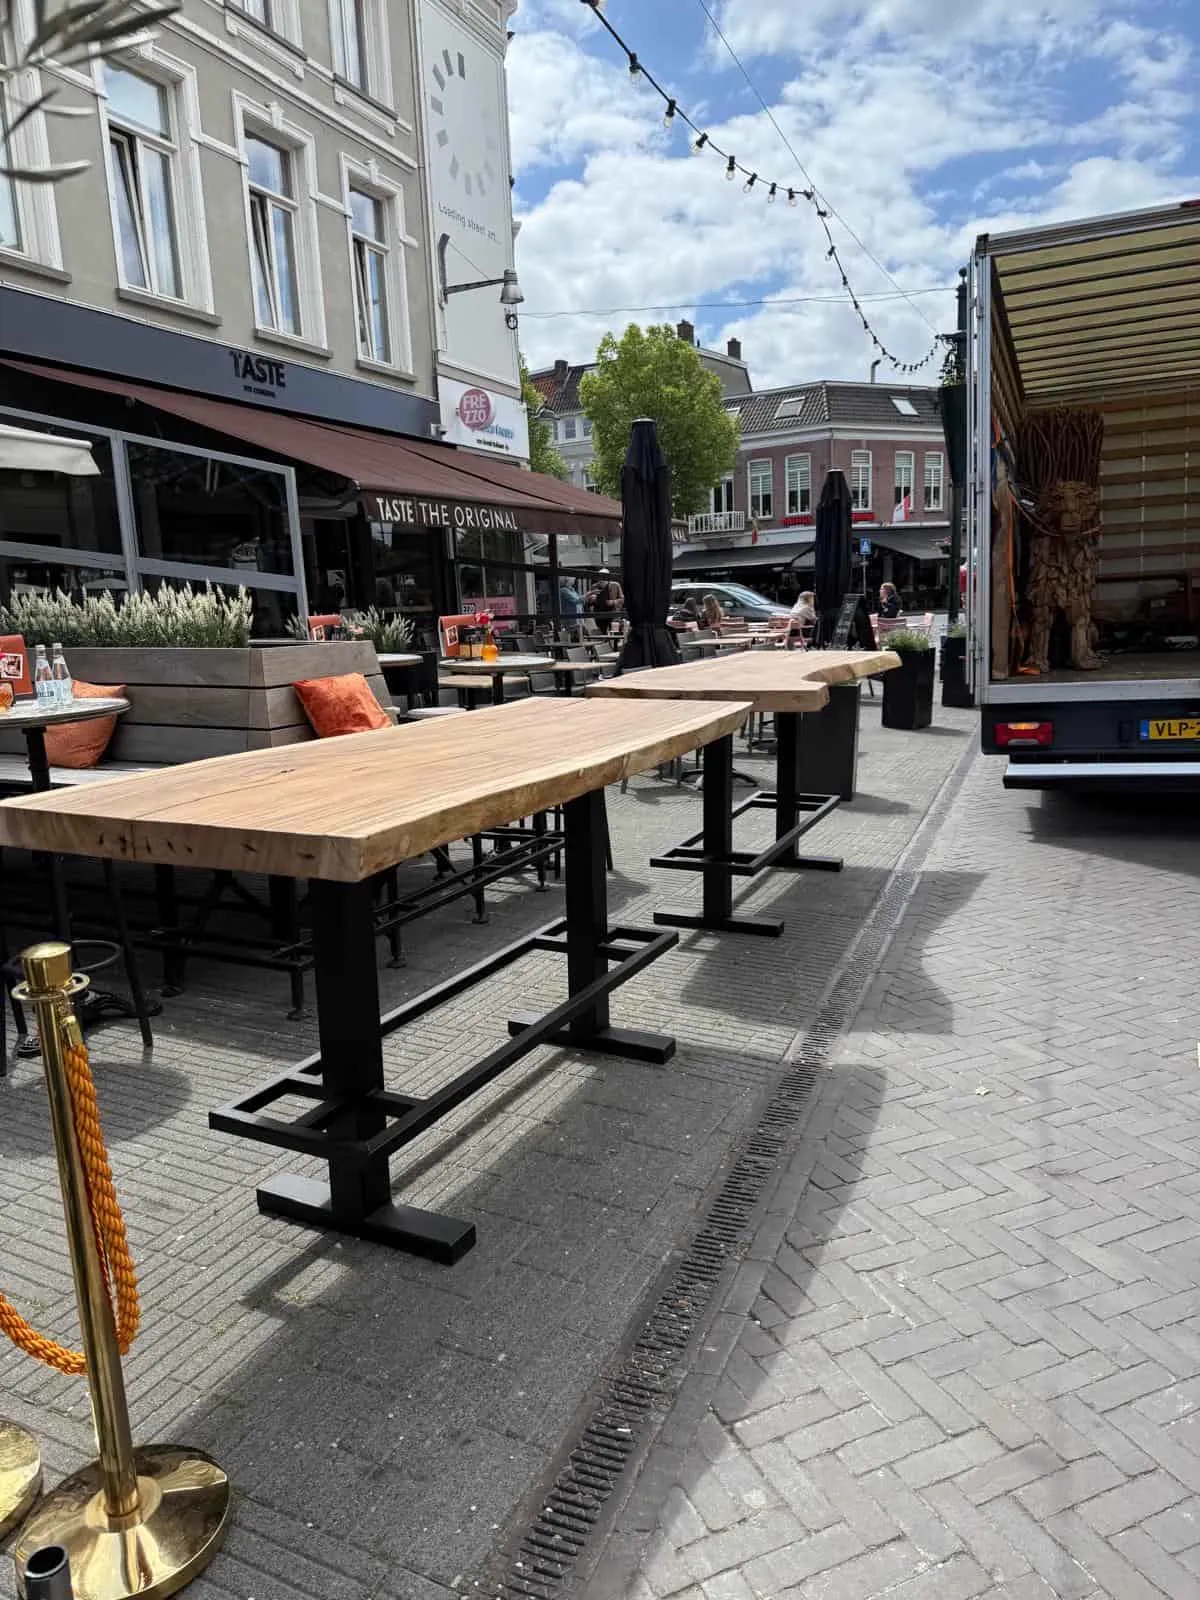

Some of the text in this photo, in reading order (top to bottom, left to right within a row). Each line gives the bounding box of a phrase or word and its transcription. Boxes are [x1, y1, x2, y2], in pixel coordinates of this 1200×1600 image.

[228, 350, 286, 388] TASTE
[463, 394, 487, 410] FRE
[463, 408, 487, 424] ZZO
[376, 498, 518, 530] TASTE THE ORIGINAL
